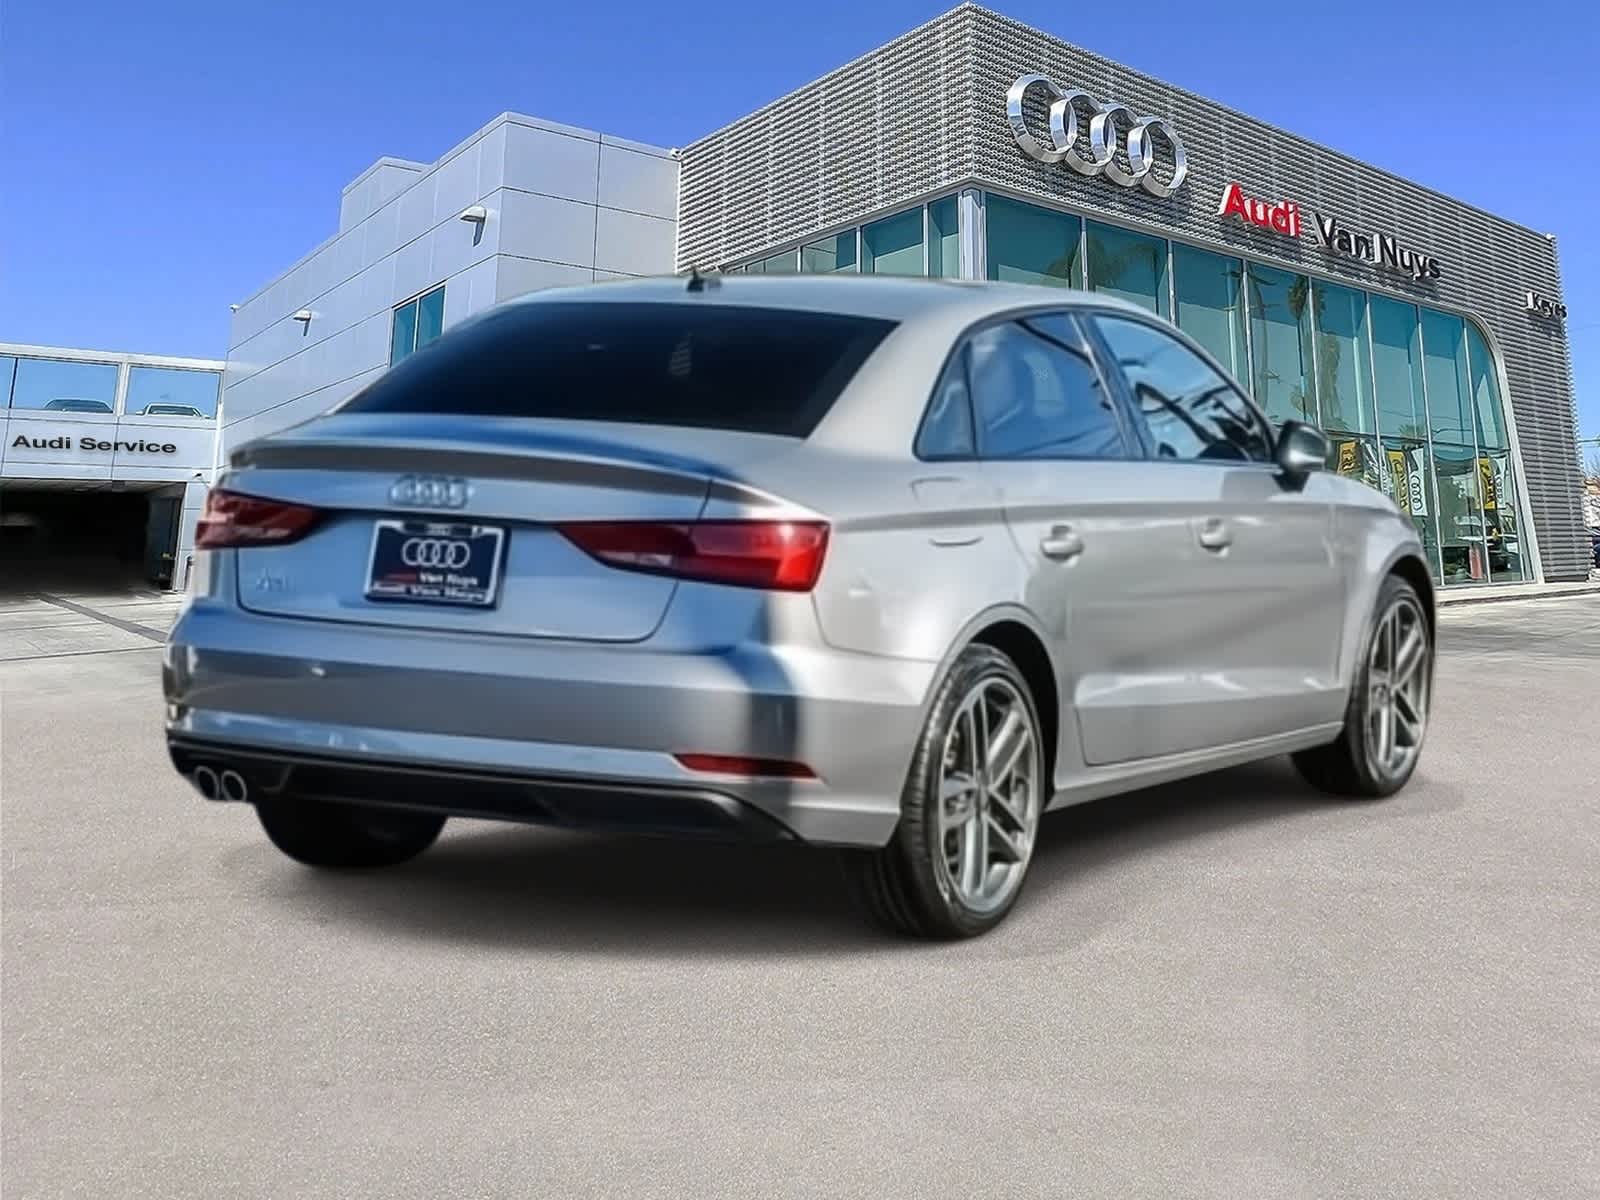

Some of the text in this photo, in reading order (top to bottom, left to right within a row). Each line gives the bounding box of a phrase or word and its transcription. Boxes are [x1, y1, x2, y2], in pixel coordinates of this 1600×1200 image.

[1218, 181, 1441, 281] Audi Van Nuys
[12, 435, 177, 453] Audi Service
